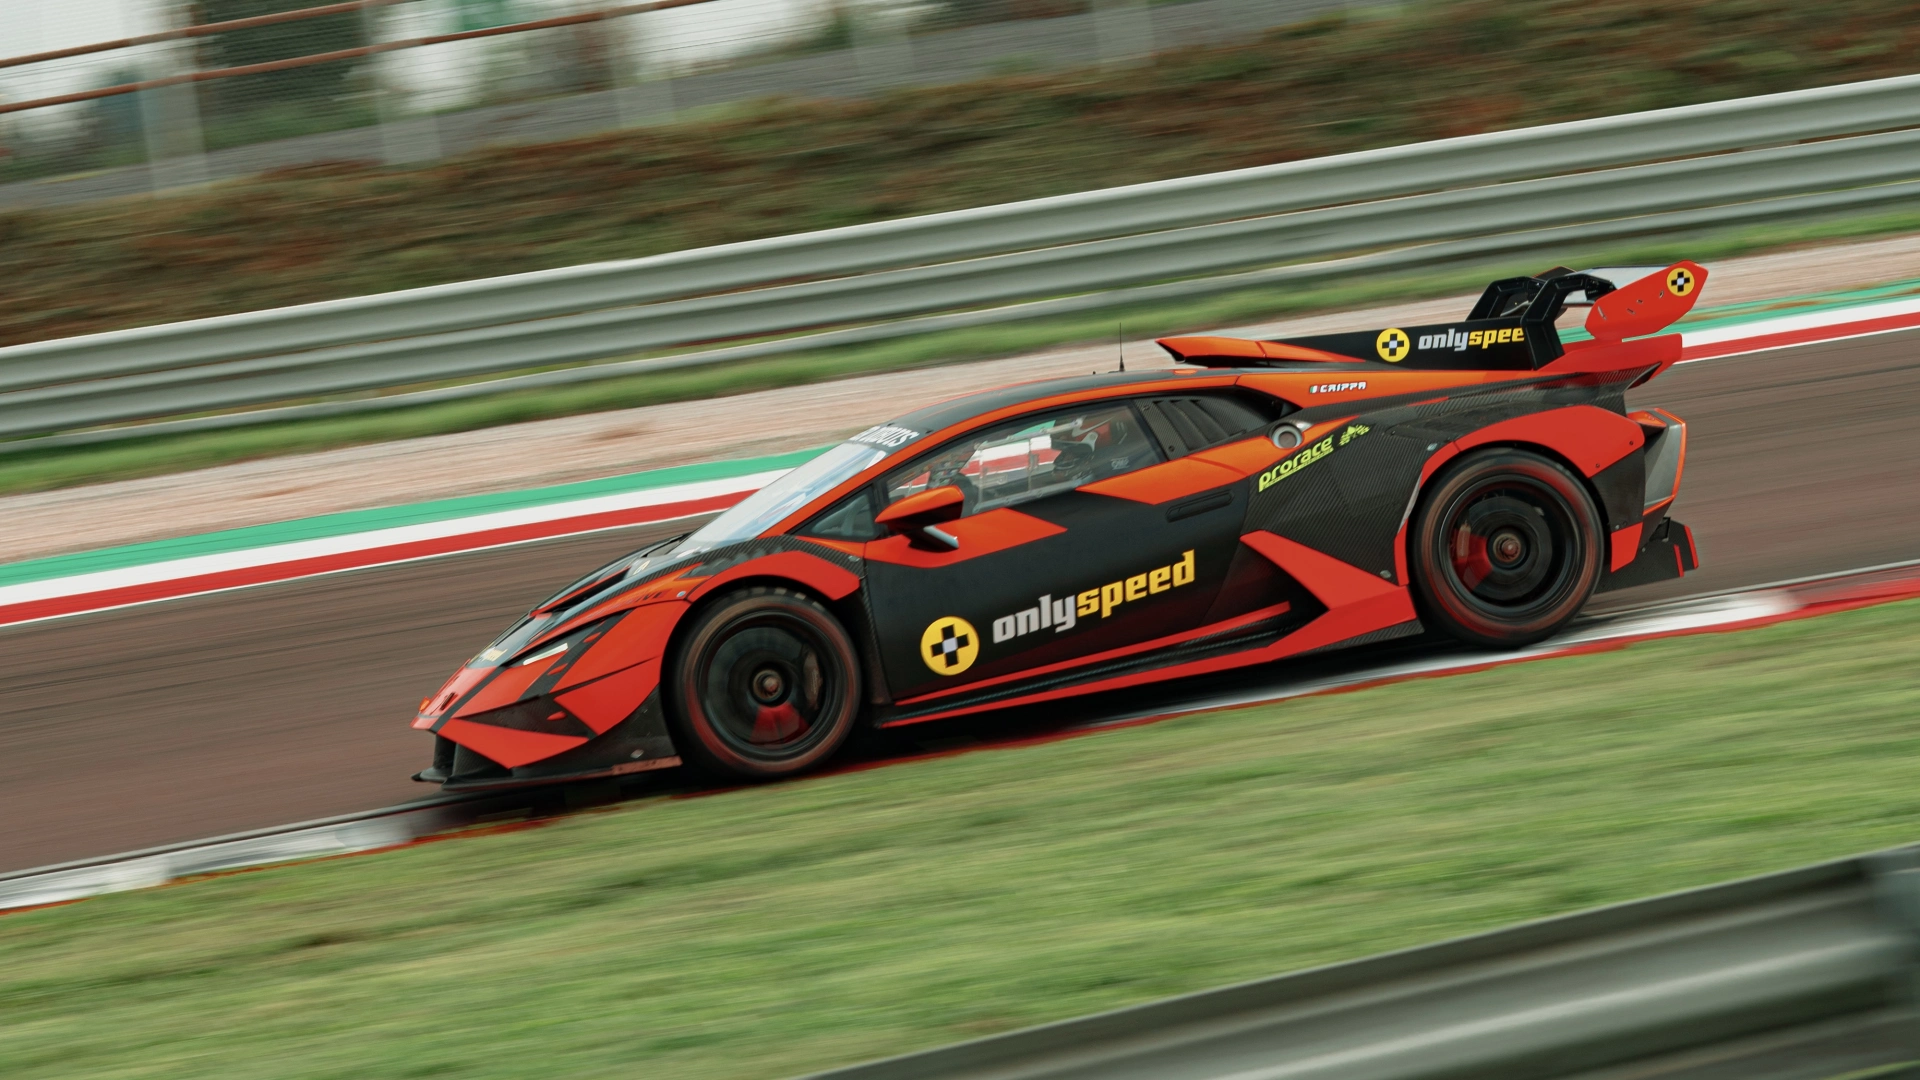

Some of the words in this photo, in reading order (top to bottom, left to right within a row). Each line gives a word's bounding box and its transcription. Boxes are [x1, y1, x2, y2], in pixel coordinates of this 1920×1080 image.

[1418, 328, 1525, 352] onlyspee
[1258, 437, 1333, 493] prorace
[992, 549, 1195, 644] onlyspeed
